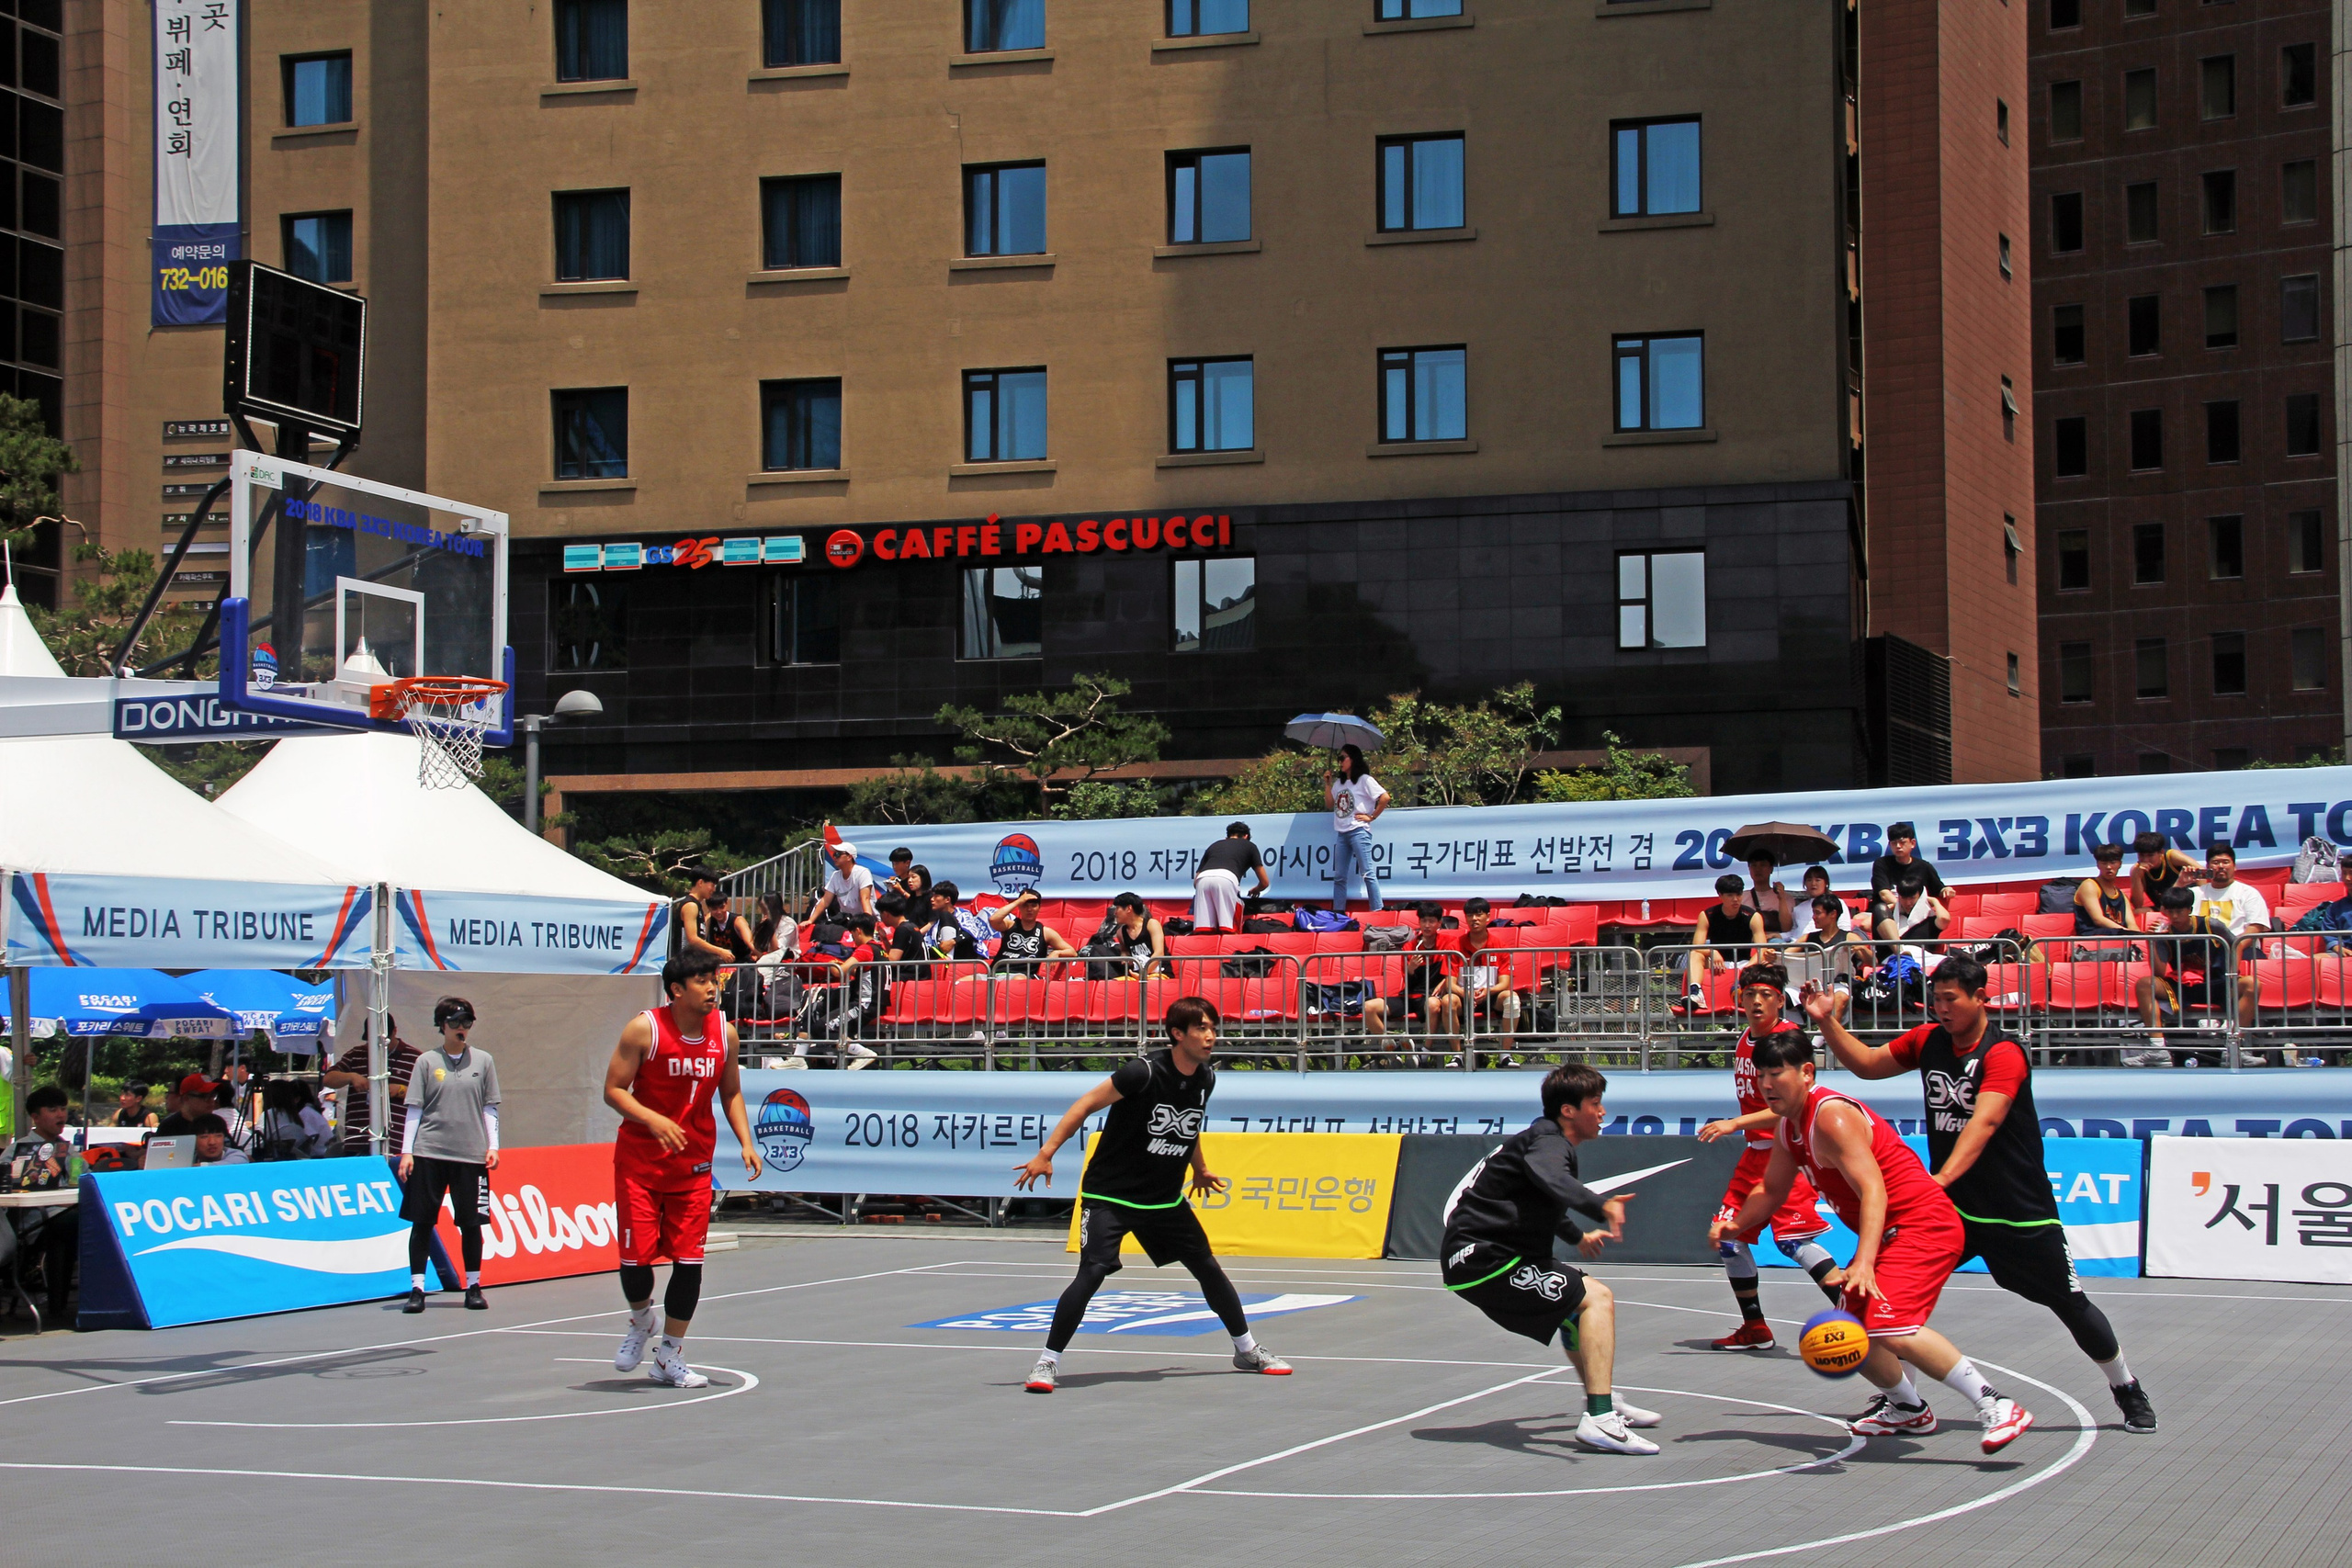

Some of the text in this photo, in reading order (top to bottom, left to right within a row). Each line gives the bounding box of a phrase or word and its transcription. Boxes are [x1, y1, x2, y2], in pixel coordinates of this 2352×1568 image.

[201, 3, 229, 31] 곳
[171, 244, 225, 260] 예약문의
[286, 498, 322, 523] 2018
[324, 506, 357, 530] KBA
[393, 522, 444, 549] KOREA
[445, 533, 485, 558] TOUR
[873, 513, 1230, 559] CAFFÉ PASCUCCI
[646, 537, 719, 570] GS25
[1070, 851, 1137, 881] 2018
[1407, 839, 1516, 879] 국가대표
[1530, 834, 1614, 874] 선발전
[1628, 832, 1655, 871] 겸
[1672, 828, 1736, 871] 20
[1937, 816, 2049, 861] 3X3
[2064, 805, 2278, 857] KOREA
[992, 864, 1040, 874] BASKETBALL
[84, 907, 313, 941] MEDIA TRIBUNE
[450, 919, 624, 950] MEDIA TRIBUNE
[668, 1057, 716, 1077] DASH
[758, 1124, 810, 1135] BASKETBALL
[844, 1112, 920, 1148] 2018
[933, 1113, 1047, 1149] 자카르타
[770, 1145, 798, 1158] 3X3
[114, 1181, 395, 1236] POCARI SWEAT
[1240, 1177, 1376, 1213] 국민은행
[2204, 1182, 2352, 1247] 서울
[1814, 1349, 1861, 1367] Wilson
